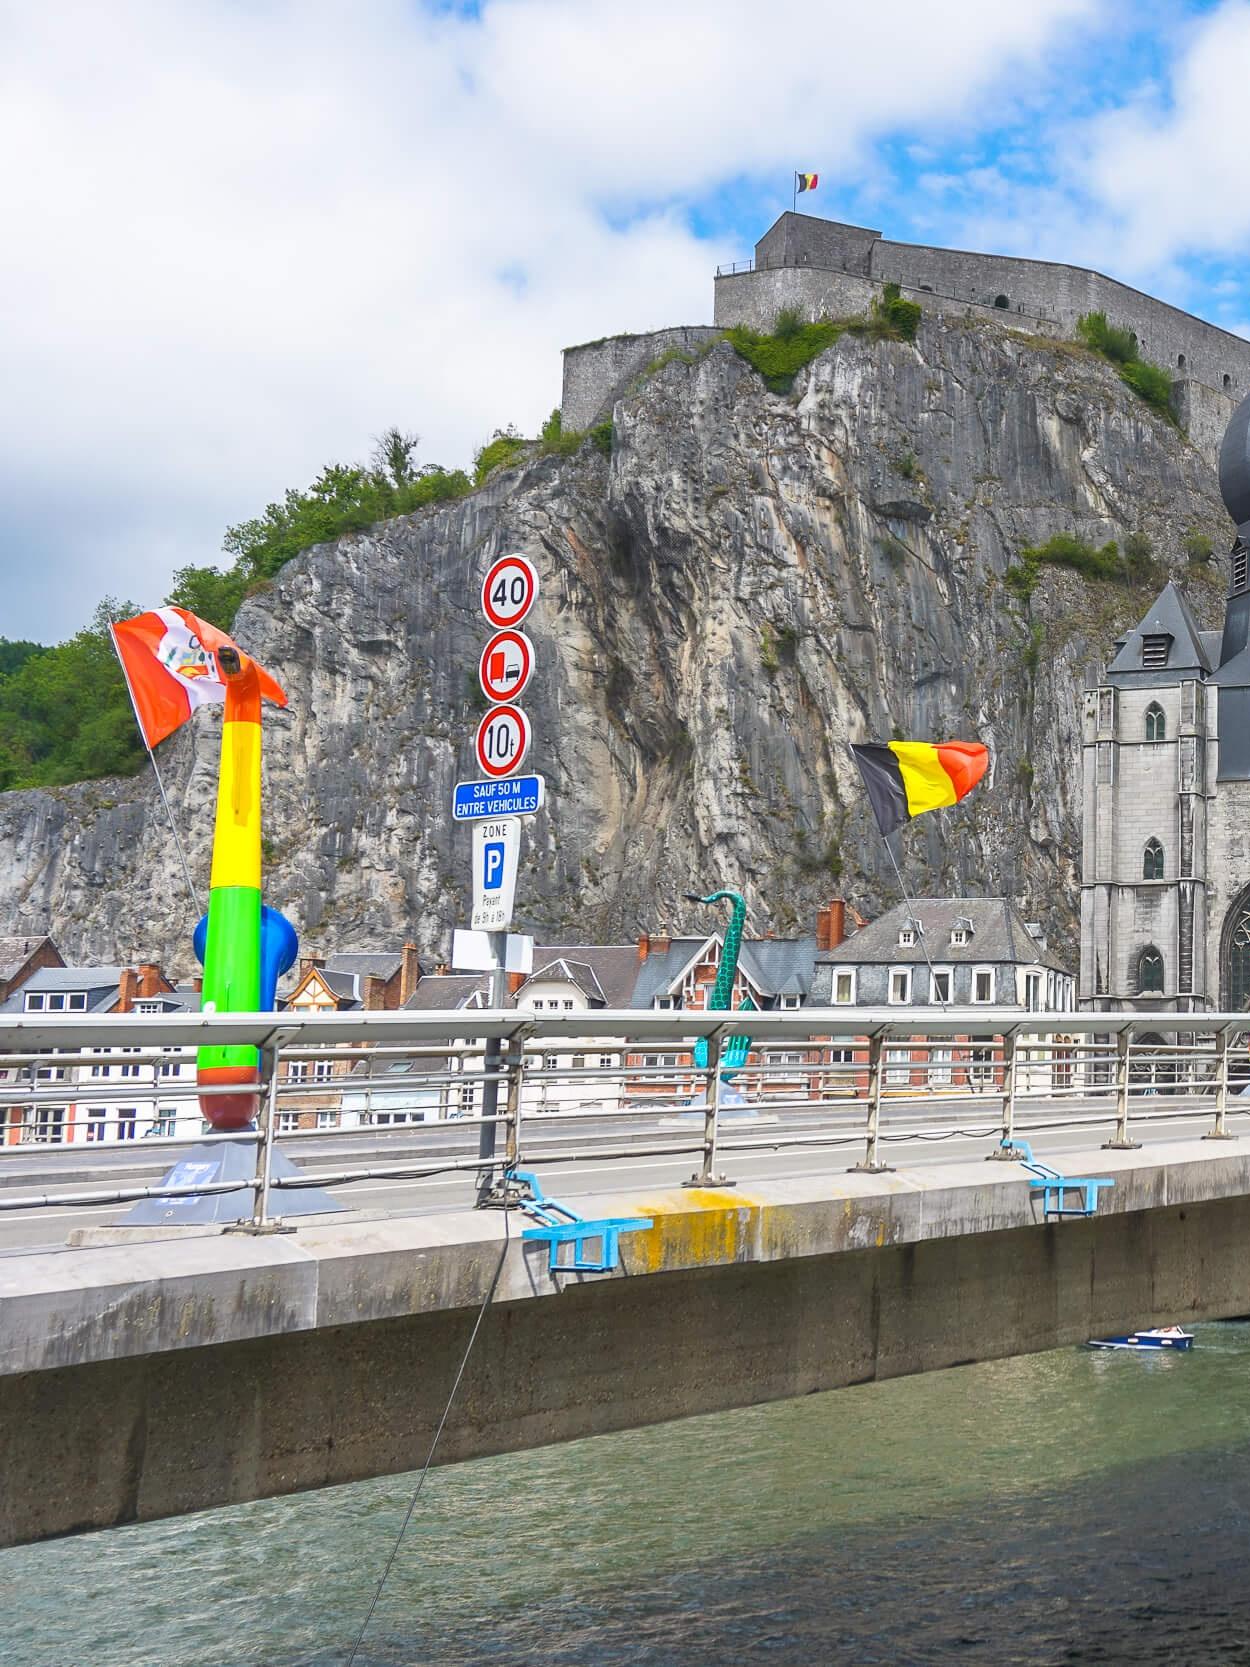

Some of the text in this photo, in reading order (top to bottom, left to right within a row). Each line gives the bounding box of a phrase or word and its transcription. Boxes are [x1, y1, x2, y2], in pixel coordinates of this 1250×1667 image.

[492, 576, 525, 607] 40
[473, 781, 520, 798] SAUF 50 M
[456, 796, 536, 816] ENTRE VEHICULES
[483, 824, 507, 838] ZONE
[488, 849, 501, 883] P
